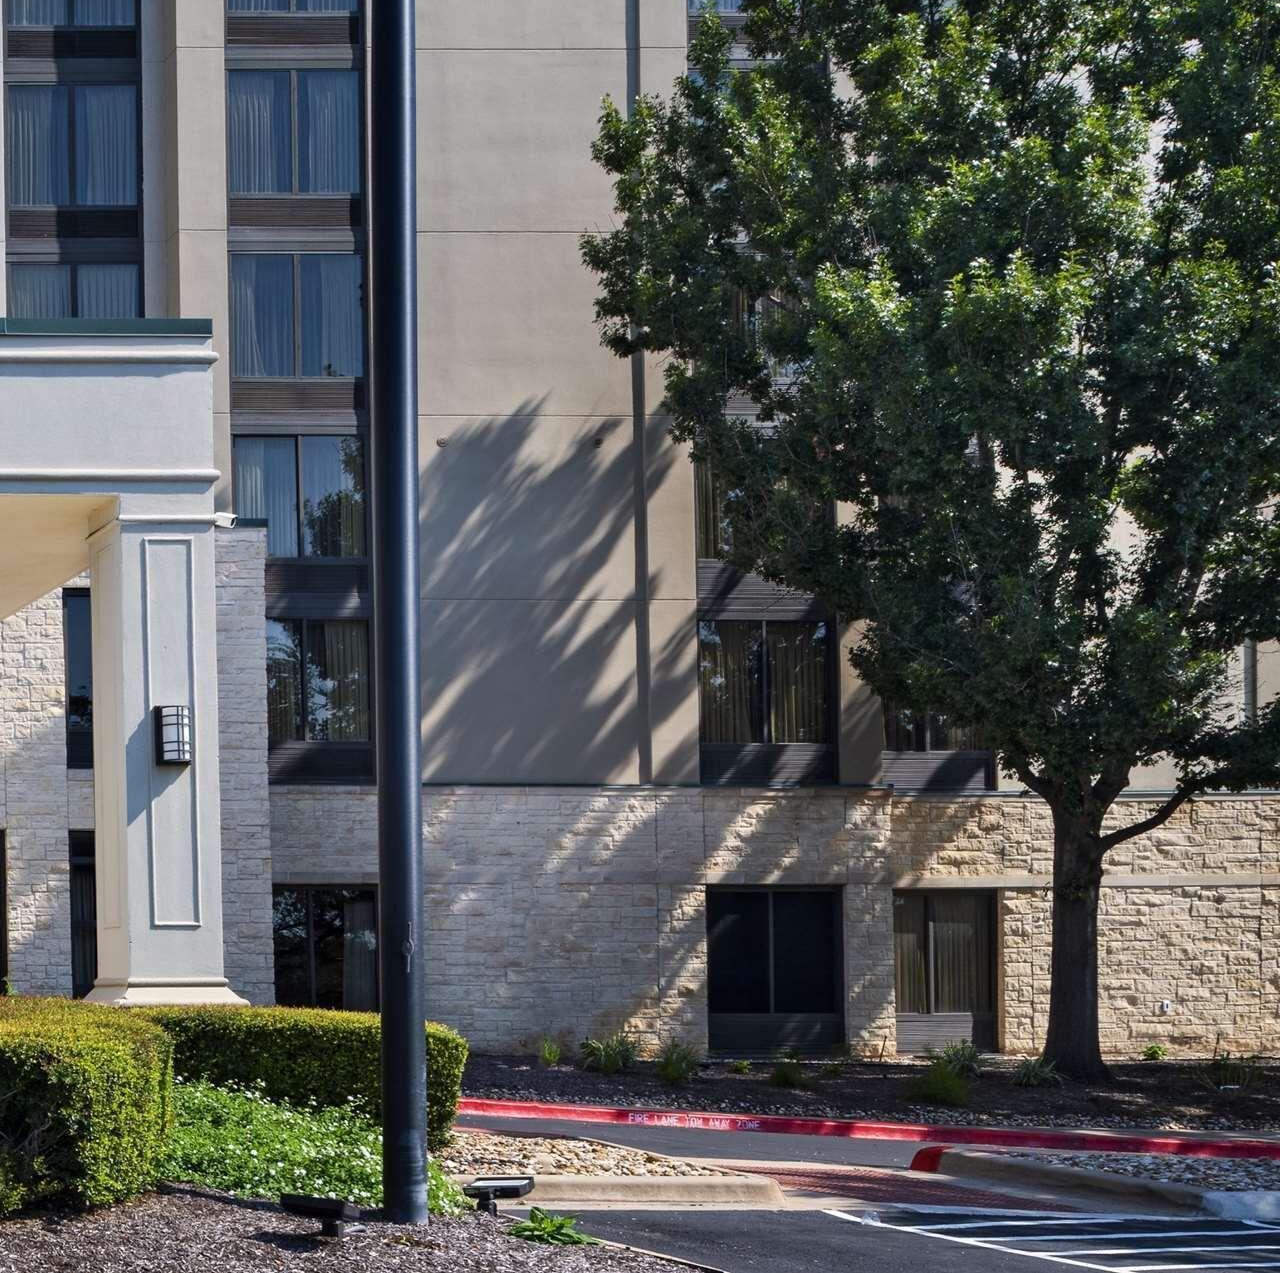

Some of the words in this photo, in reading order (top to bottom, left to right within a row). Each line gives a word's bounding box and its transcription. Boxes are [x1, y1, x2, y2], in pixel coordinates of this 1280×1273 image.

[627, 1112, 649, 1124] FIRE
[653, 1114, 679, 1127] LANE
[684, 1115, 703, 1129] TOW
[708, 1117, 730, 1130] AWAY
[736, 1119, 761, 1130] ZONE
